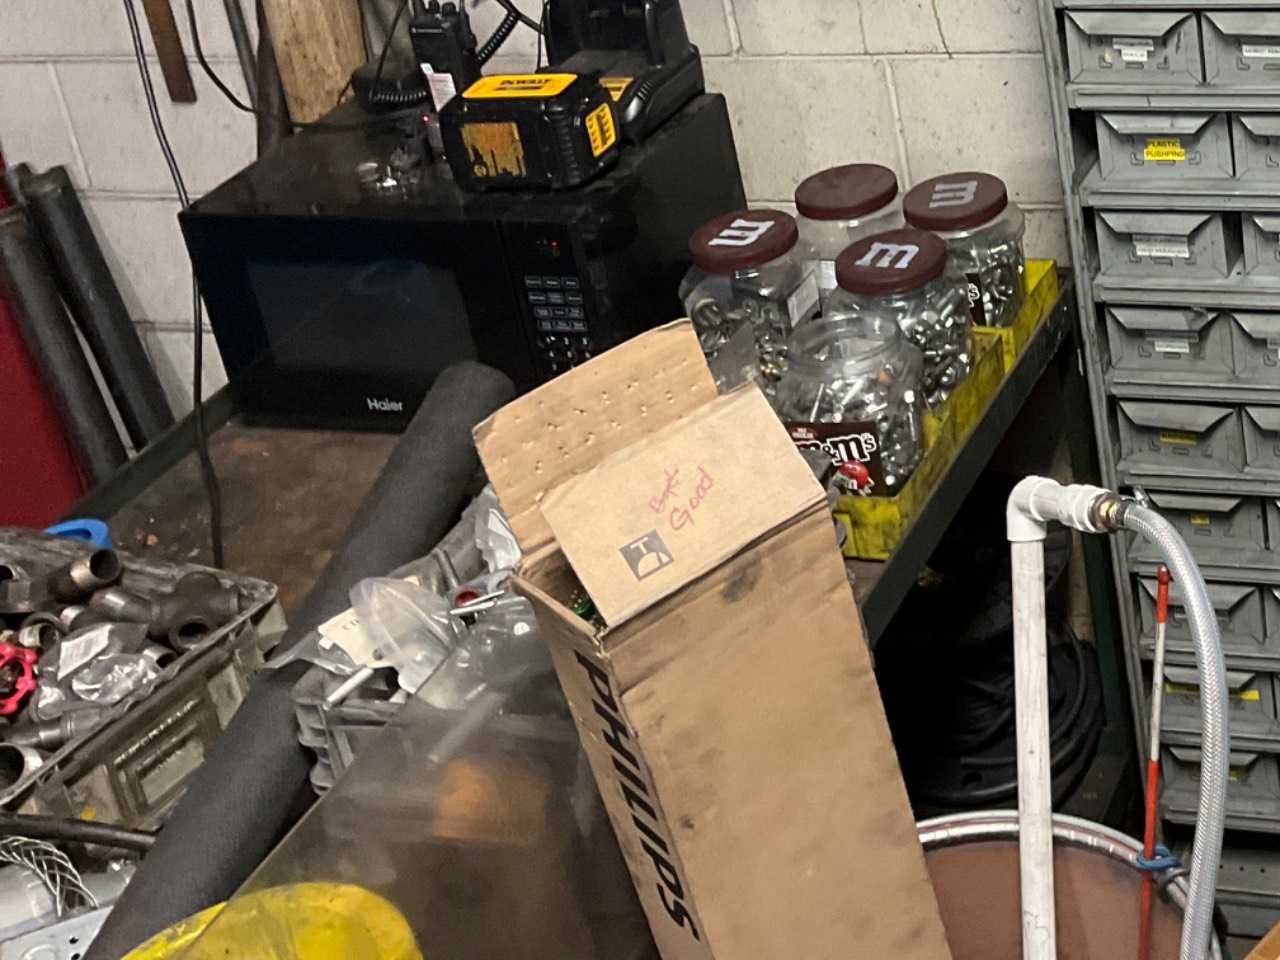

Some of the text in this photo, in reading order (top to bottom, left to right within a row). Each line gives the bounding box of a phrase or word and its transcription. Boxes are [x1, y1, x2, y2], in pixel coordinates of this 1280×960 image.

[854, 241, 920, 269] m
[366, 397, 403, 411] Haier
[670, 464, 715, 530] Good
[575, 651, 700, 941] PHILIPS
